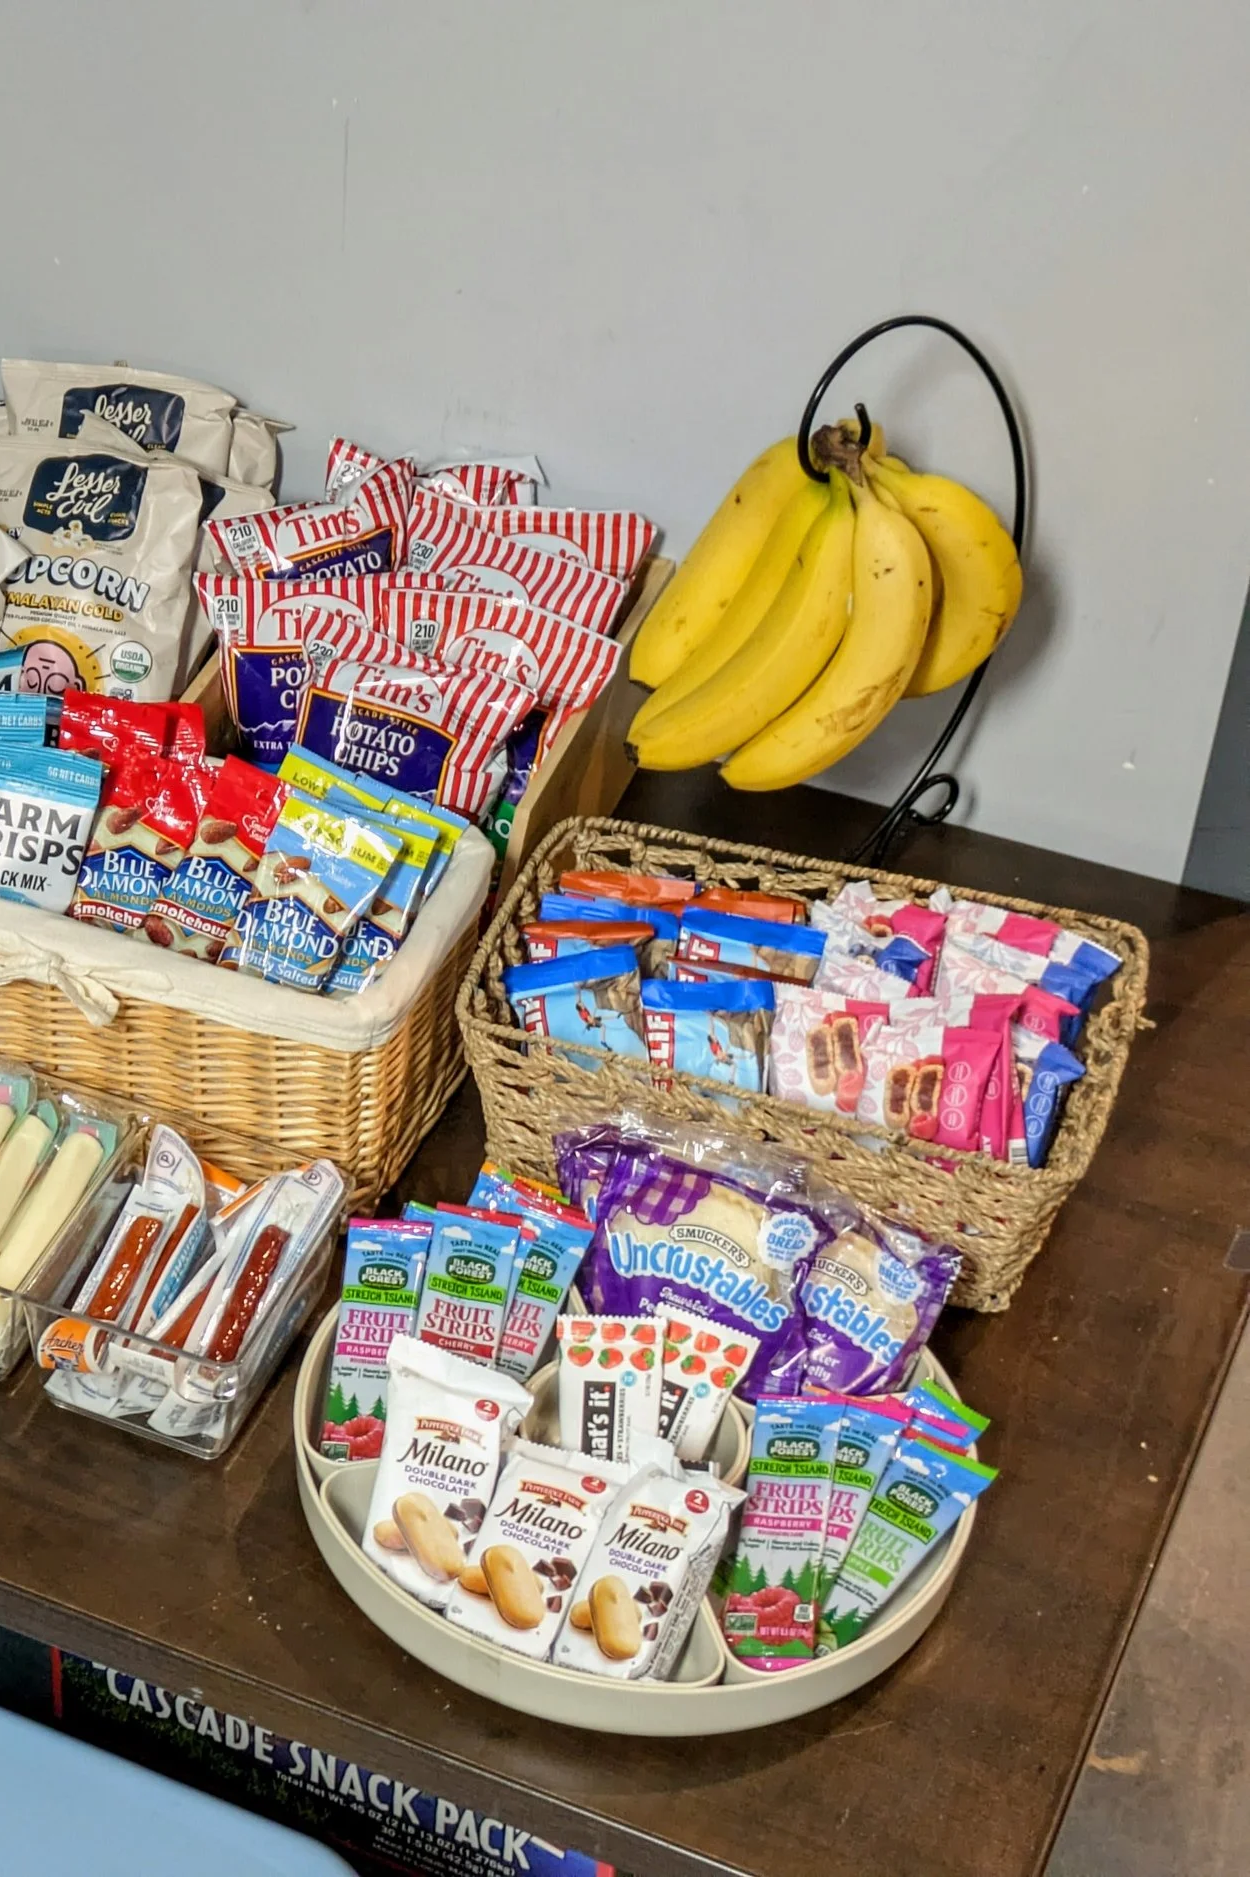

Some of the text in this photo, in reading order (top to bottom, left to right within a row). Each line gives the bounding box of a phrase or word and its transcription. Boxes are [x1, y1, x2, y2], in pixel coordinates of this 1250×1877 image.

[46, 462, 121, 502] Lesser
[56, 489, 114, 524] Evil
[229, 524, 252, 543] 210
[298, 548, 343, 572] CASCADE
[410, 542, 434, 560] 230
[301, 551, 383, 581] POTATO
[81, 602, 124, 624] GOLD
[216, 599, 239, 613] 210
[414, 623, 436, 639] 210
[120, 649, 145, 664] USDA
[114, 661, 148, 676] ORGANIC
[351, 663, 437, 714] Tim's
[18, 715, 43, 727] CARBS
[253, 740, 284, 750] EXTRA
[330, 716, 416, 756] POTATO
[334, 740, 401, 777] CHIPS
[291, 772, 319, 792] LOW
[103, 850, 156, 879] BLUE
[186, 856, 241, 892] BLUE
[162, 871, 252, 911] DIAMOND
[168, 892, 232, 918] ALMONDS
[263, 897, 319, 936] BLUE
[234, 908, 339, 959] DIAMOND
[250, 939, 314, 966] ALMONDS
[276, 964, 319, 988] Salted
[676, 1226, 748, 1267] SMUCKER'S
[767, 1235, 806, 1250] BREAD
[364, 1266, 404, 1279] BLACK
[449, 1264, 493, 1280] FOREST
[452, 1257, 491, 1271] BLACK
[361, 1274, 406, 1286] FOREST
[430, 1277, 468, 1295] STRETCH
[610, 1232, 788, 1332] Uncrustables
[344, 1288, 382, 1303] STRETCH
[347, 1308, 410, 1328] FRUIT
[433, 1297, 494, 1323] FRUIT
[424, 1313, 496, 1342] STRIPS
[42, 1329, 84, 1352] Archer
[437, 1337, 476, 1352] CHERRY
[483, 1401, 493, 1412] 2
[617, 1387, 626, 1443] STRAWBERRIES
[769, 1446, 817, 1458] FOREST
[773, 1439, 815, 1449] BLACK
[396, 1437, 487, 1478] Milano
[751, 1461, 792, 1473] STRETCH
[404, 1464, 478, 1490] DOUBLE DARK
[407, 1475, 470, 1497] CHOCOLATE
[590, 1475, 600, 1487] 2
[692, 1492, 704, 1505] 2
[754, 1480, 822, 1500] FRUIT
[897, 1484, 937, 1505] BLACK
[747, 1498, 823, 1516] STRIPS
[889, 1487, 932, 1519] FOREST
[494, 1497, 585, 1540] Milano
[753, 1517, 812, 1530] RASPBERRY
[500, 1518, 572, 1551] DOUBLE DARK
[501, 1529, 563, 1556] CHOCOLATE
[604, 1523, 682, 1562] Milano
[608, 1548, 669, 1574] DOUBLE DARK
[609, 1557, 661, 1579] CHOCOLATE
[105, 1666, 275, 1765] CASCADE
[288, 1740, 421, 1825] SNACK
[434, 1797, 531, 1870] PACK
[275, 1771, 303, 1788] Total
[306, 1783, 326, 1796] Net
[401, 1823, 416, 1836] LB
[380, 1825, 396, 1839] 30
